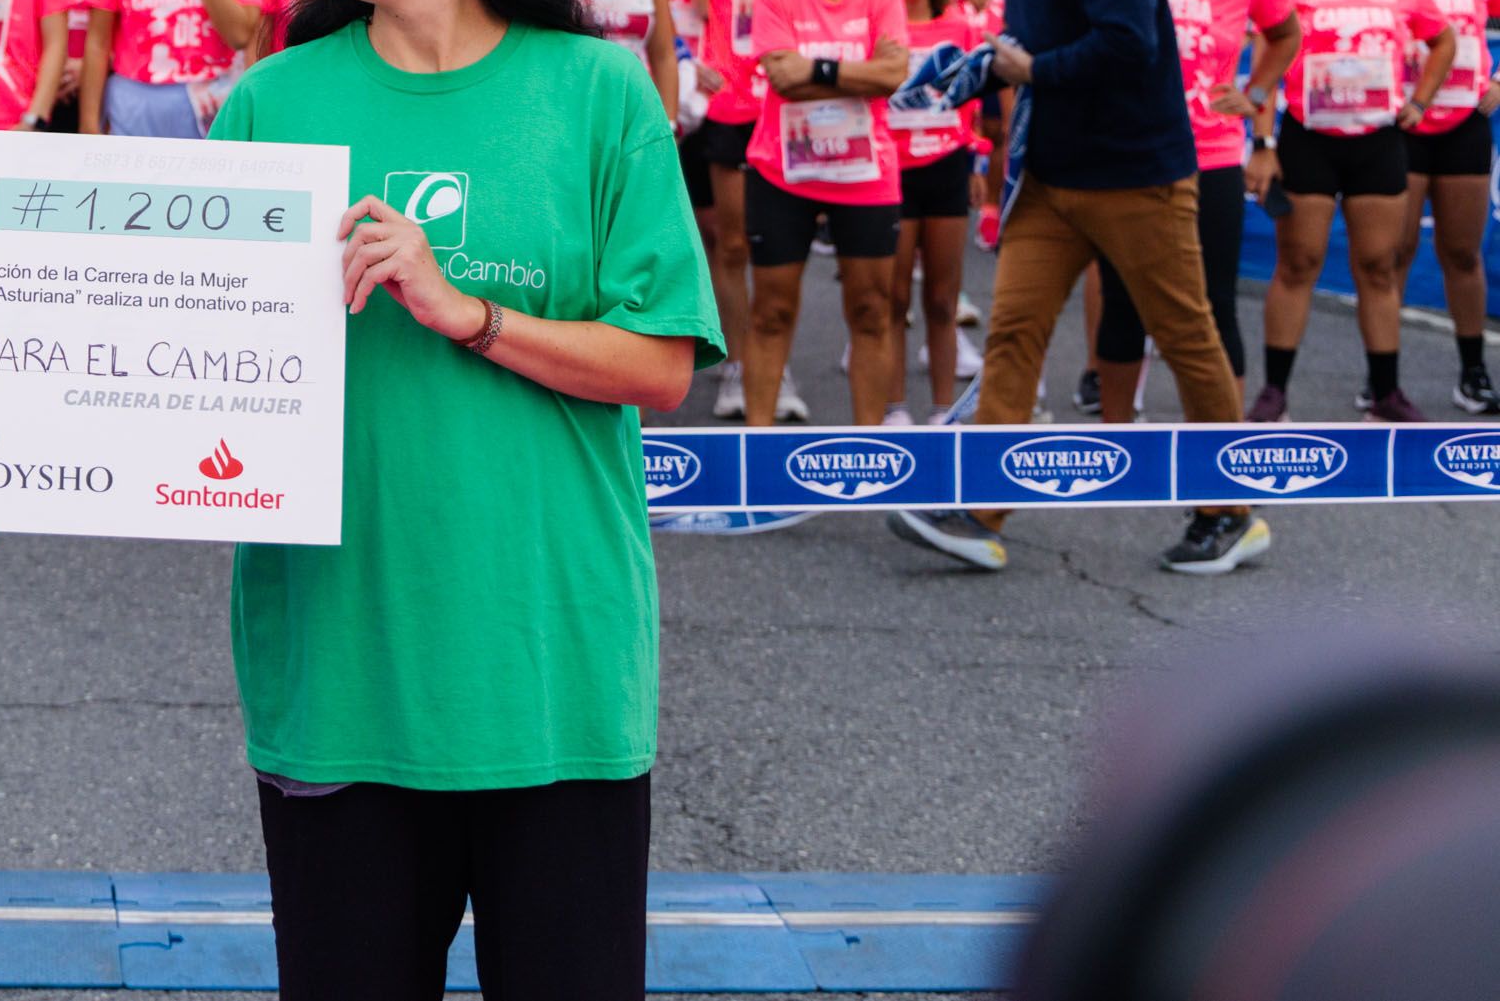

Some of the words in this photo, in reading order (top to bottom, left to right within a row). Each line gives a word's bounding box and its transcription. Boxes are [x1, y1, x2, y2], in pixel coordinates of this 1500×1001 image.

[262, 207, 286, 233] €
[37, 266, 58, 281] de
[64, 266, 78, 281] la
[84, 267, 148, 284] Carrera
[153, 270, 175, 286] de
[180, 271, 195, 287] la
[200, 272, 249, 291] Mujer
[448, 252, 546, 289] Cambio
[87, 291, 143, 307] realiza
[148, 295, 169, 309] un
[174, 295, 247, 312] donativo
[251, 300, 295, 315] para:
[87, 343, 129, 377] EL
[63, 389, 161, 409] CARRERA
[166, 393, 194, 410] DE
[199, 395, 225, 412] LA
[229, 396, 302, 415] MUJER
[797, 453, 905, 477] ASTURIANA
[1011, 450, 1121, 474] ASTURIANA
[1227, 447, 1338, 471] ASTURIANA
[155, 483, 285, 510] Santander
